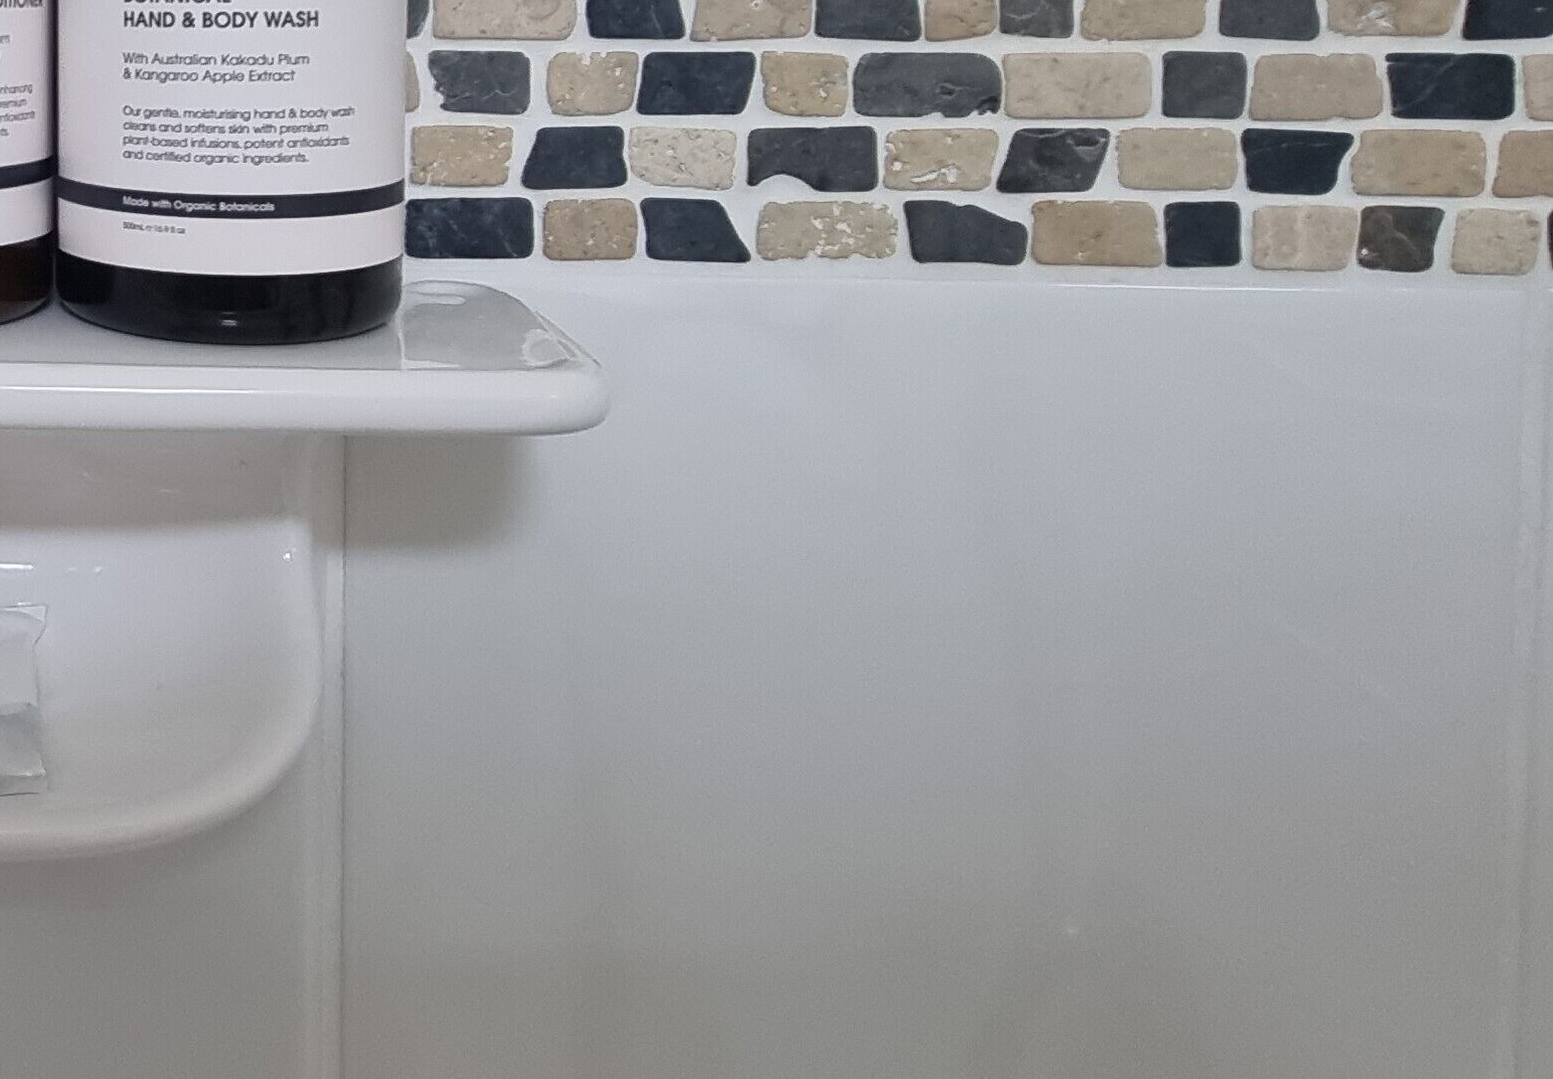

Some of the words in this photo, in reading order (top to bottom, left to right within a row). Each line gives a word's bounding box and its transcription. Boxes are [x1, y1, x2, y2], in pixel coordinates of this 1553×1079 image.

[123, 11, 175, 29] HAND
[182, 11, 196, 28] &
[202, 11, 259, 29] BODY
[264, 10, 319, 28] WASH
[123, 52, 148, 64] With
[151, 53, 217, 65] Australian
[221, 53, 274, 66] Kakadu
[278, 54, 310, 65] Plum
[123, 68, 132, 79] &
[135, 69, 198, 83] Kangaroo
[202, 70, 245, 84] Apple
[248, 70, 296, 82] Extract
[123, 196, 149, 207] Made
[152, 199, 171, 209] with
[173, 200, 216, 212] Organic
[219, 202, 275, 212] Botanicals
